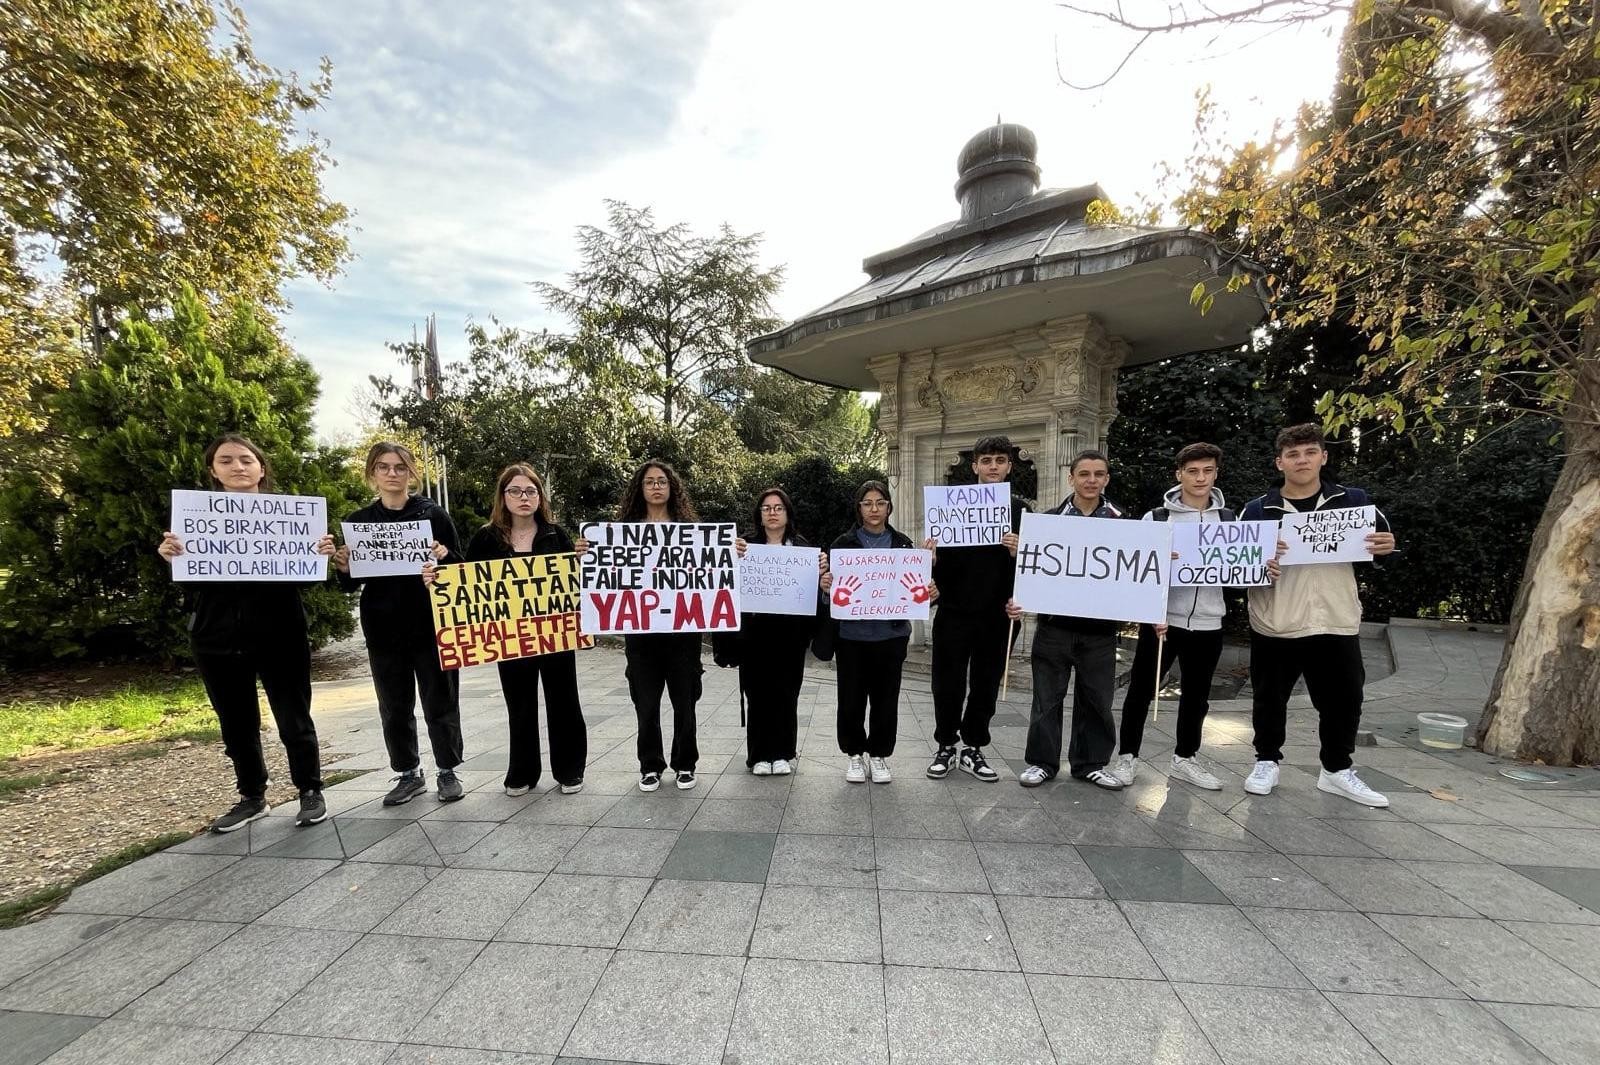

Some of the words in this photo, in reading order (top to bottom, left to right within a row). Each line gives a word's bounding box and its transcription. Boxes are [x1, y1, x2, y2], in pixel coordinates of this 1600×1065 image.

[946, 486, 996, 506] KADIN
[250, 499, 318, 516] ADALET
[927, 504, 1011, 524] CİNAYETLERİ
[184, 518, 218, 535] BOŞ
[224, 519, 310, 535] BIRAKTIM
[371, 531, 403, 539] BENSEM
[582, 522, 735, 548] CİNAYETE
[1198, 523, 1260, 546] KADIN
[1303, 530, 1346, 543] HERKES
[583, 545, 653, 567] SEBEP
[656, 547, 734, 568] ARAMA
[902, 555, 923, 564] KAN
[1018, 543, 1161, 585] #SUSMA
[187, 560, 222, 575] BEN
[227, 560, 318, 575] OLABİLİRİM
[582, 567, 644, 590] FAİLE
[652, 567, 735, 590] İNDİRİM
[434, 574, 581, 607] SANATTAN
[871, 588, 887, 598] DE
[438, 601, 511, 627] İLHAM
[590, 589, 738, 631] YAP-MA
[439, 631, 591, 671] BESLENİR
